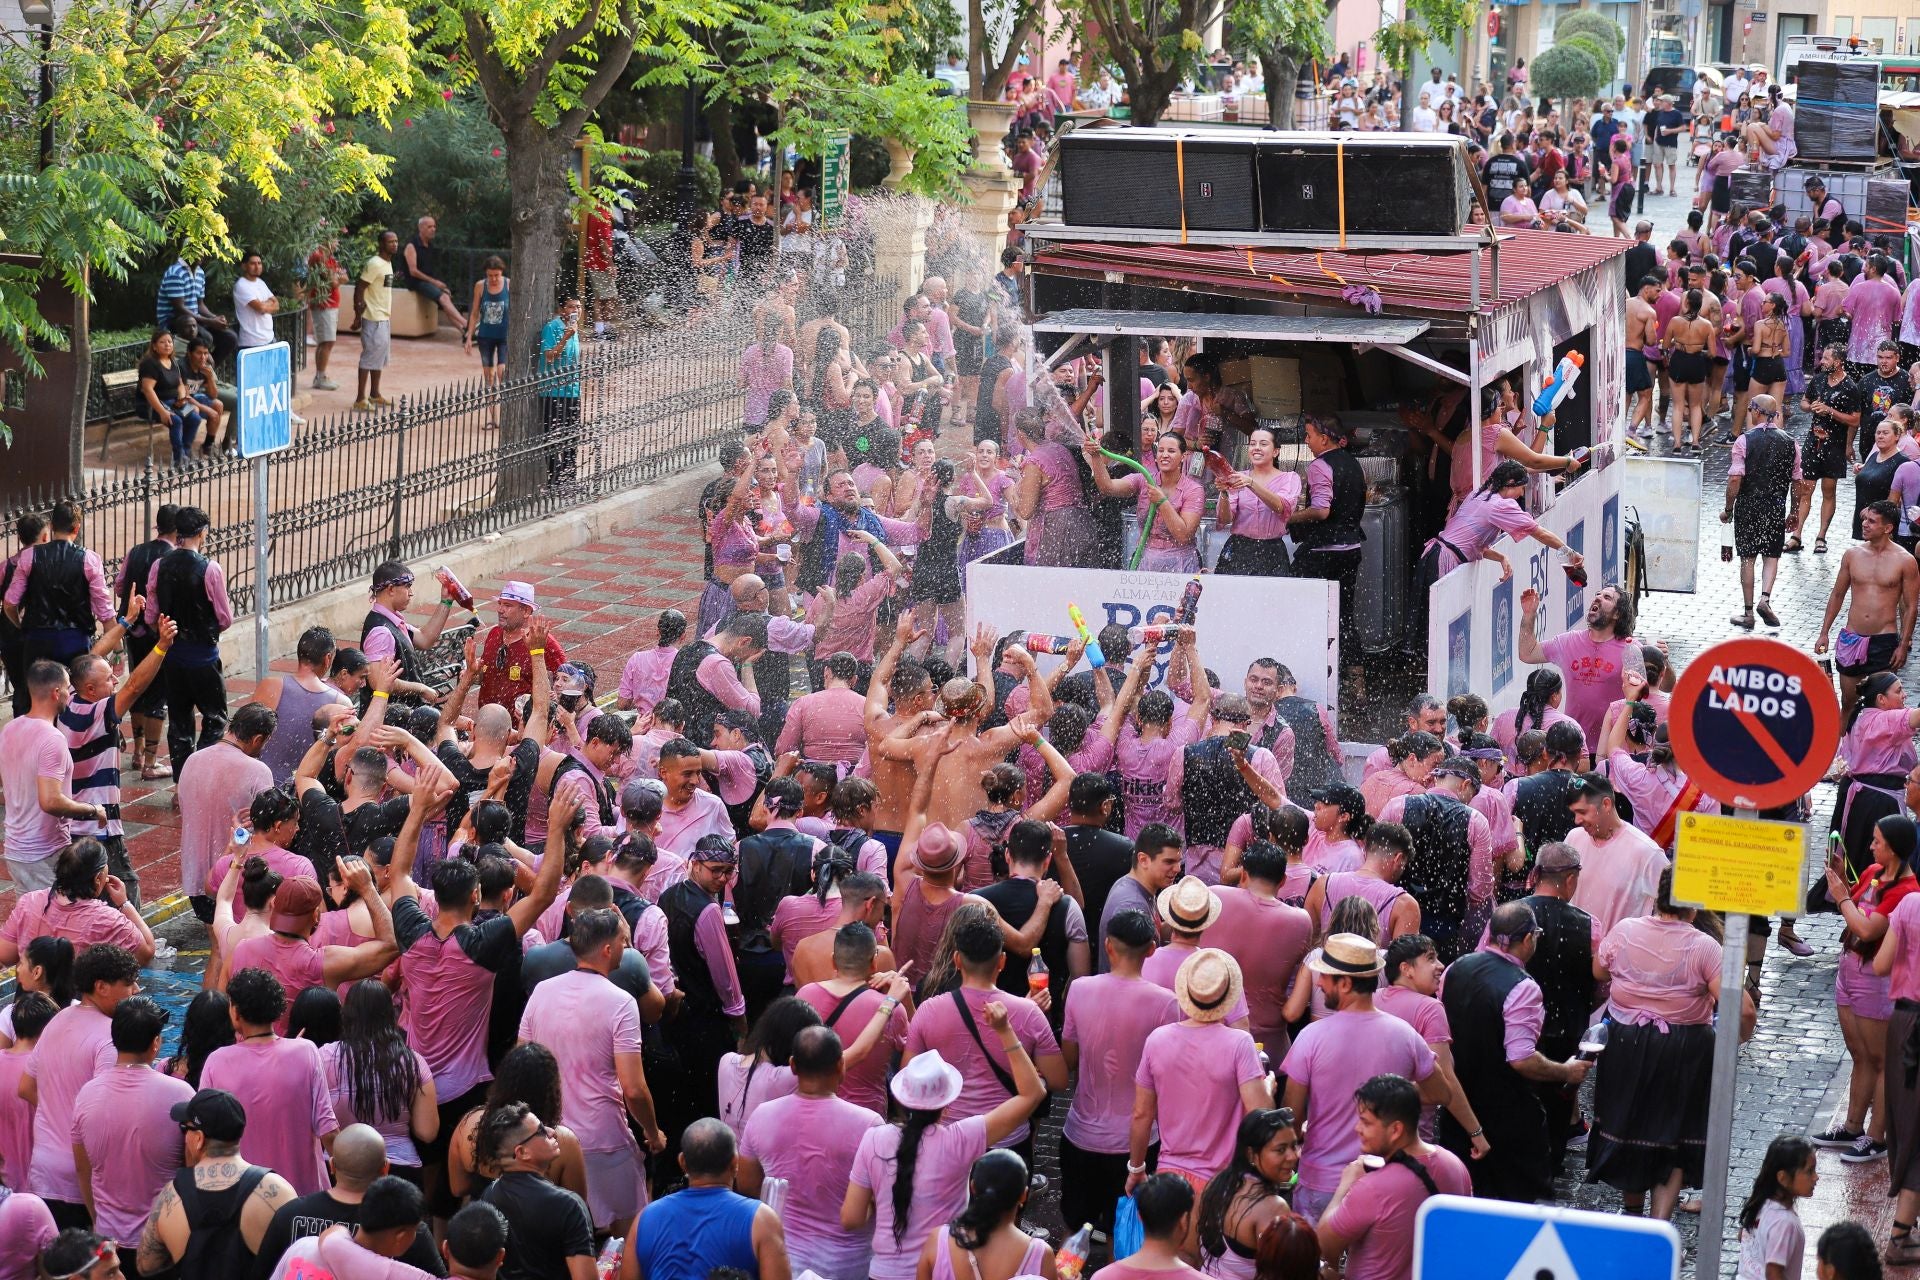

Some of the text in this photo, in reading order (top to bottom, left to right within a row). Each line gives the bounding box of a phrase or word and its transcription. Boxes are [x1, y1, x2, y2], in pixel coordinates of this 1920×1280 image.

[244, 381, 287, 419] TAXI
[1120, 574, 1180, 587] BODEGAS
[1707, 664, 1802, 695] AMBOS
[1708, 689, 1796, 719] LADOS
